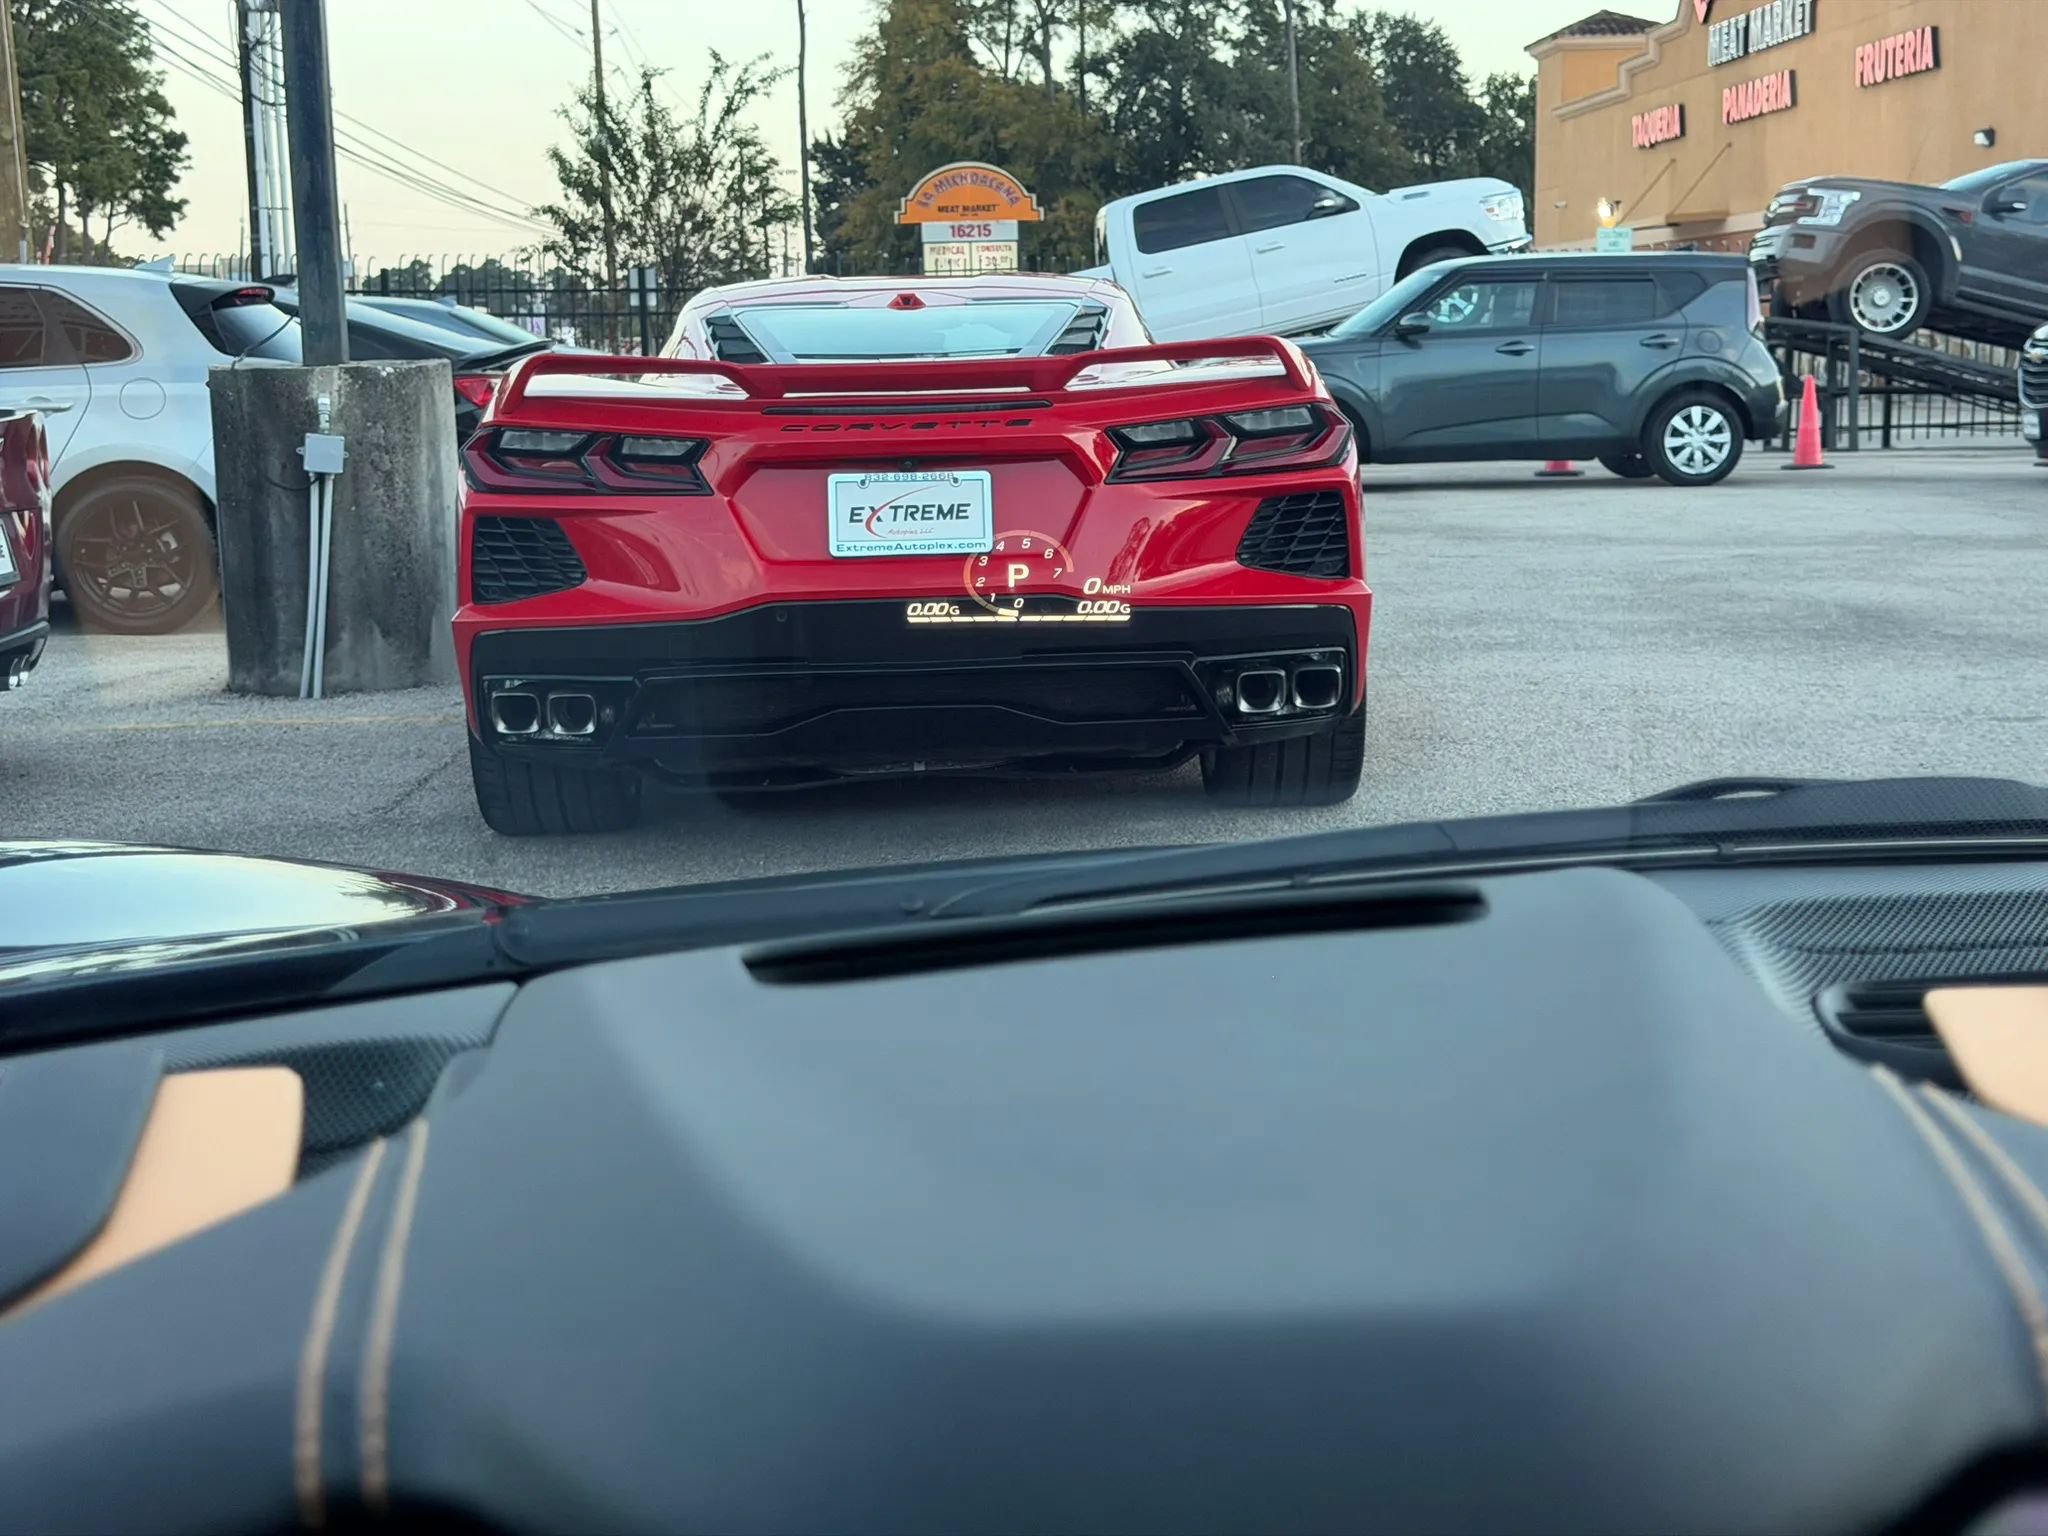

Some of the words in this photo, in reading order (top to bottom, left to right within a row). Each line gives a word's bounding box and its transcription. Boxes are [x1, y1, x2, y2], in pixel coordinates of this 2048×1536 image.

[1707, 14, 1747, 68] MEAT
[1748, 0, 1813, 53] MARKET
[1855, 26, 1935, 88] FRUTERIA
[1722, 69, 1793, 125] PANADERIA
[1632, 103, 1681, 148] TAQUERIA
[937, 205, 960, 213] MEAT
[962, 203, 996, 212] MARKET
[950, 224, 992, 238] 16215
[780, 418, 1033, 432] CORVETTE
[849, 503, 971, 523] EXTREME
[836, 541, 987, 553] ExtremeAutoplex.com
[996, 541, 1006, 551] 4
[1021, 537, 1032, 549] 5
[1044, 548, 1054, 560] 6
[978, 556, 989, 567] 3
[1008, 563, 1030, 588] P
[1053, 567, 1063, 579] 7
[975, 577, 986, 588] 2
[990, 593, 997, 603] 1
[1013, 597, 1025, 609] 0
